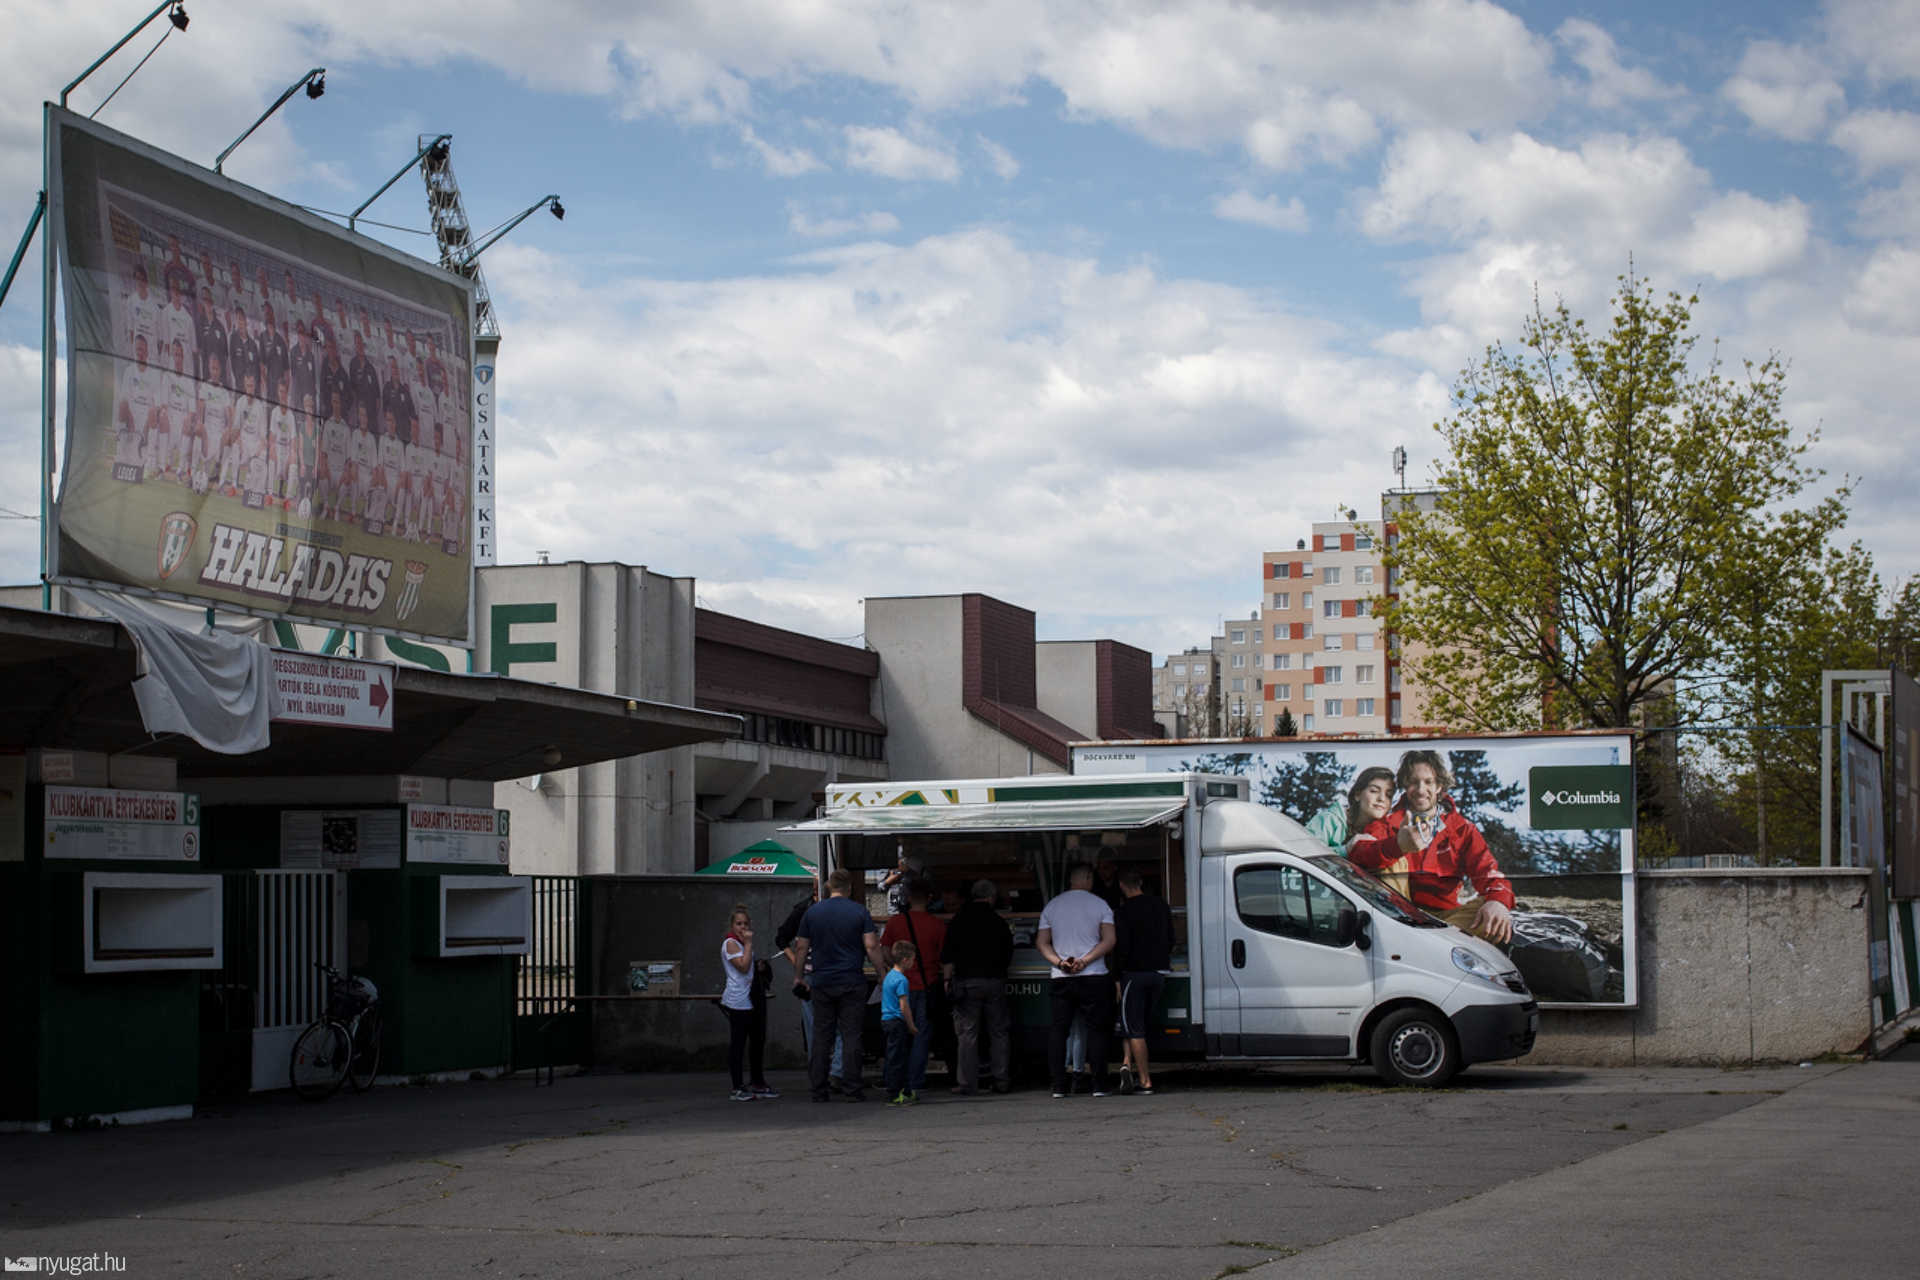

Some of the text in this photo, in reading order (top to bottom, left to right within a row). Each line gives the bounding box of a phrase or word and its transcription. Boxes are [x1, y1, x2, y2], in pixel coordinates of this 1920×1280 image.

[476, 391, 492, 558] CSATÁR KFT.
[50, 791, 113, 819] KLUBKÁRTYA
[187, 795, 198, 824] 5
[1556, 789, 1621, 804] Columbia
[499, 812, 508, 836] 6
